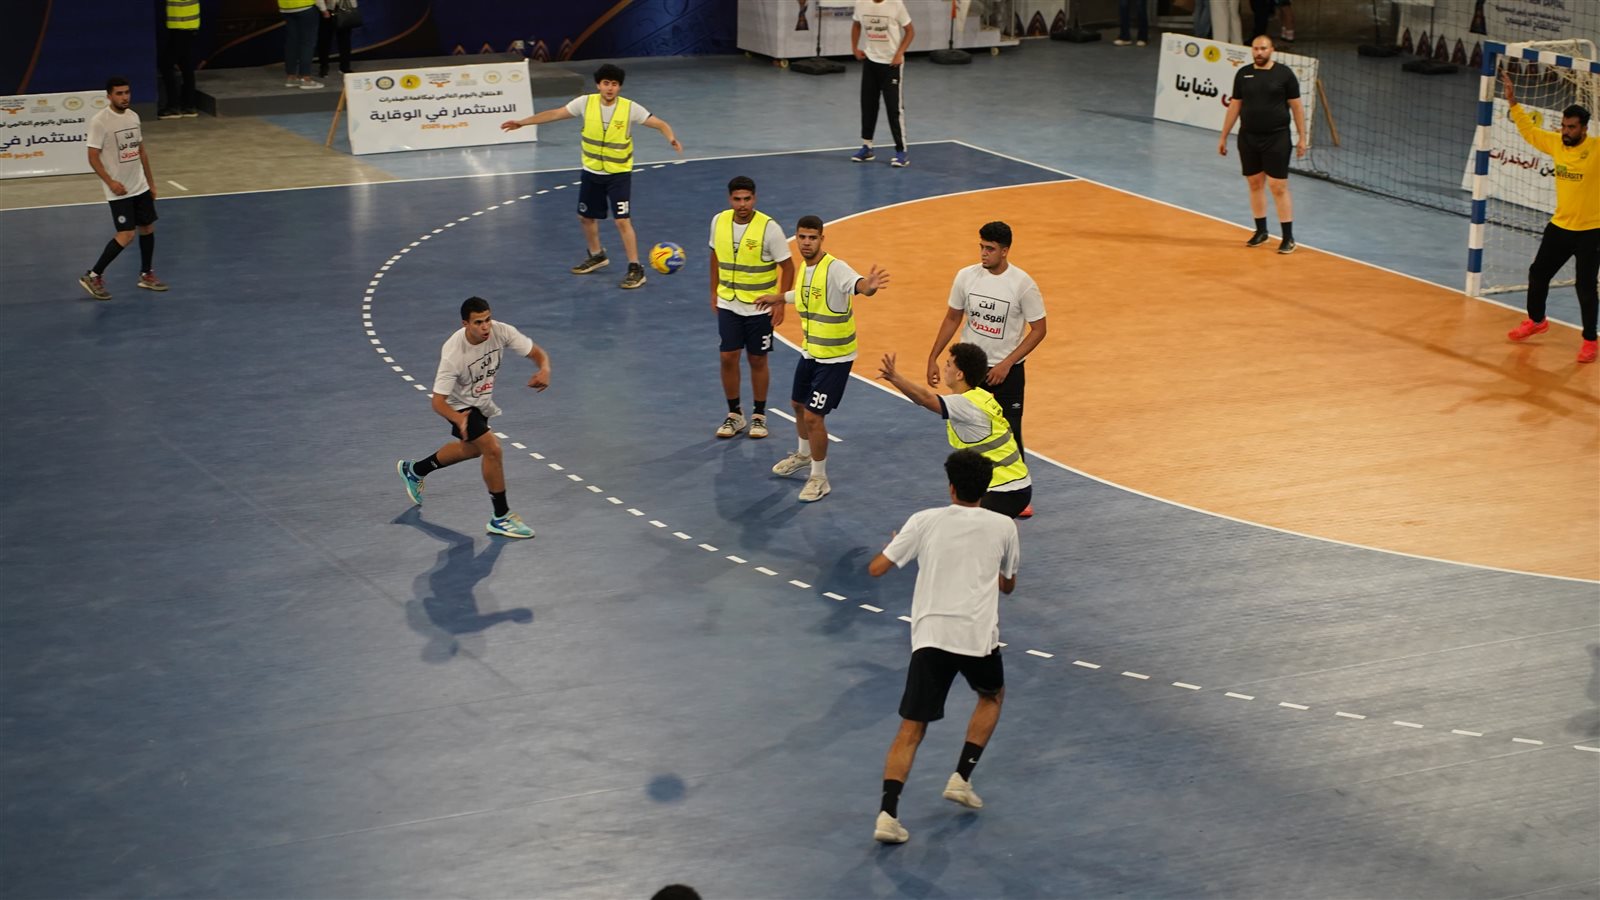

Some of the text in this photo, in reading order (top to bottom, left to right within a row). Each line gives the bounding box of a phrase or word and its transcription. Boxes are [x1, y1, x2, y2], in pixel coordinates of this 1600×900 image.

[1176, 74, 1219, 100] شبابنا
[370, 104, 516, 122] الاستثمار في الوقاية
[25, 132, 87, 146] استثمار
[1488, 147, 1539, 170] المخدرات
[810, 391, 827, 409] 39
